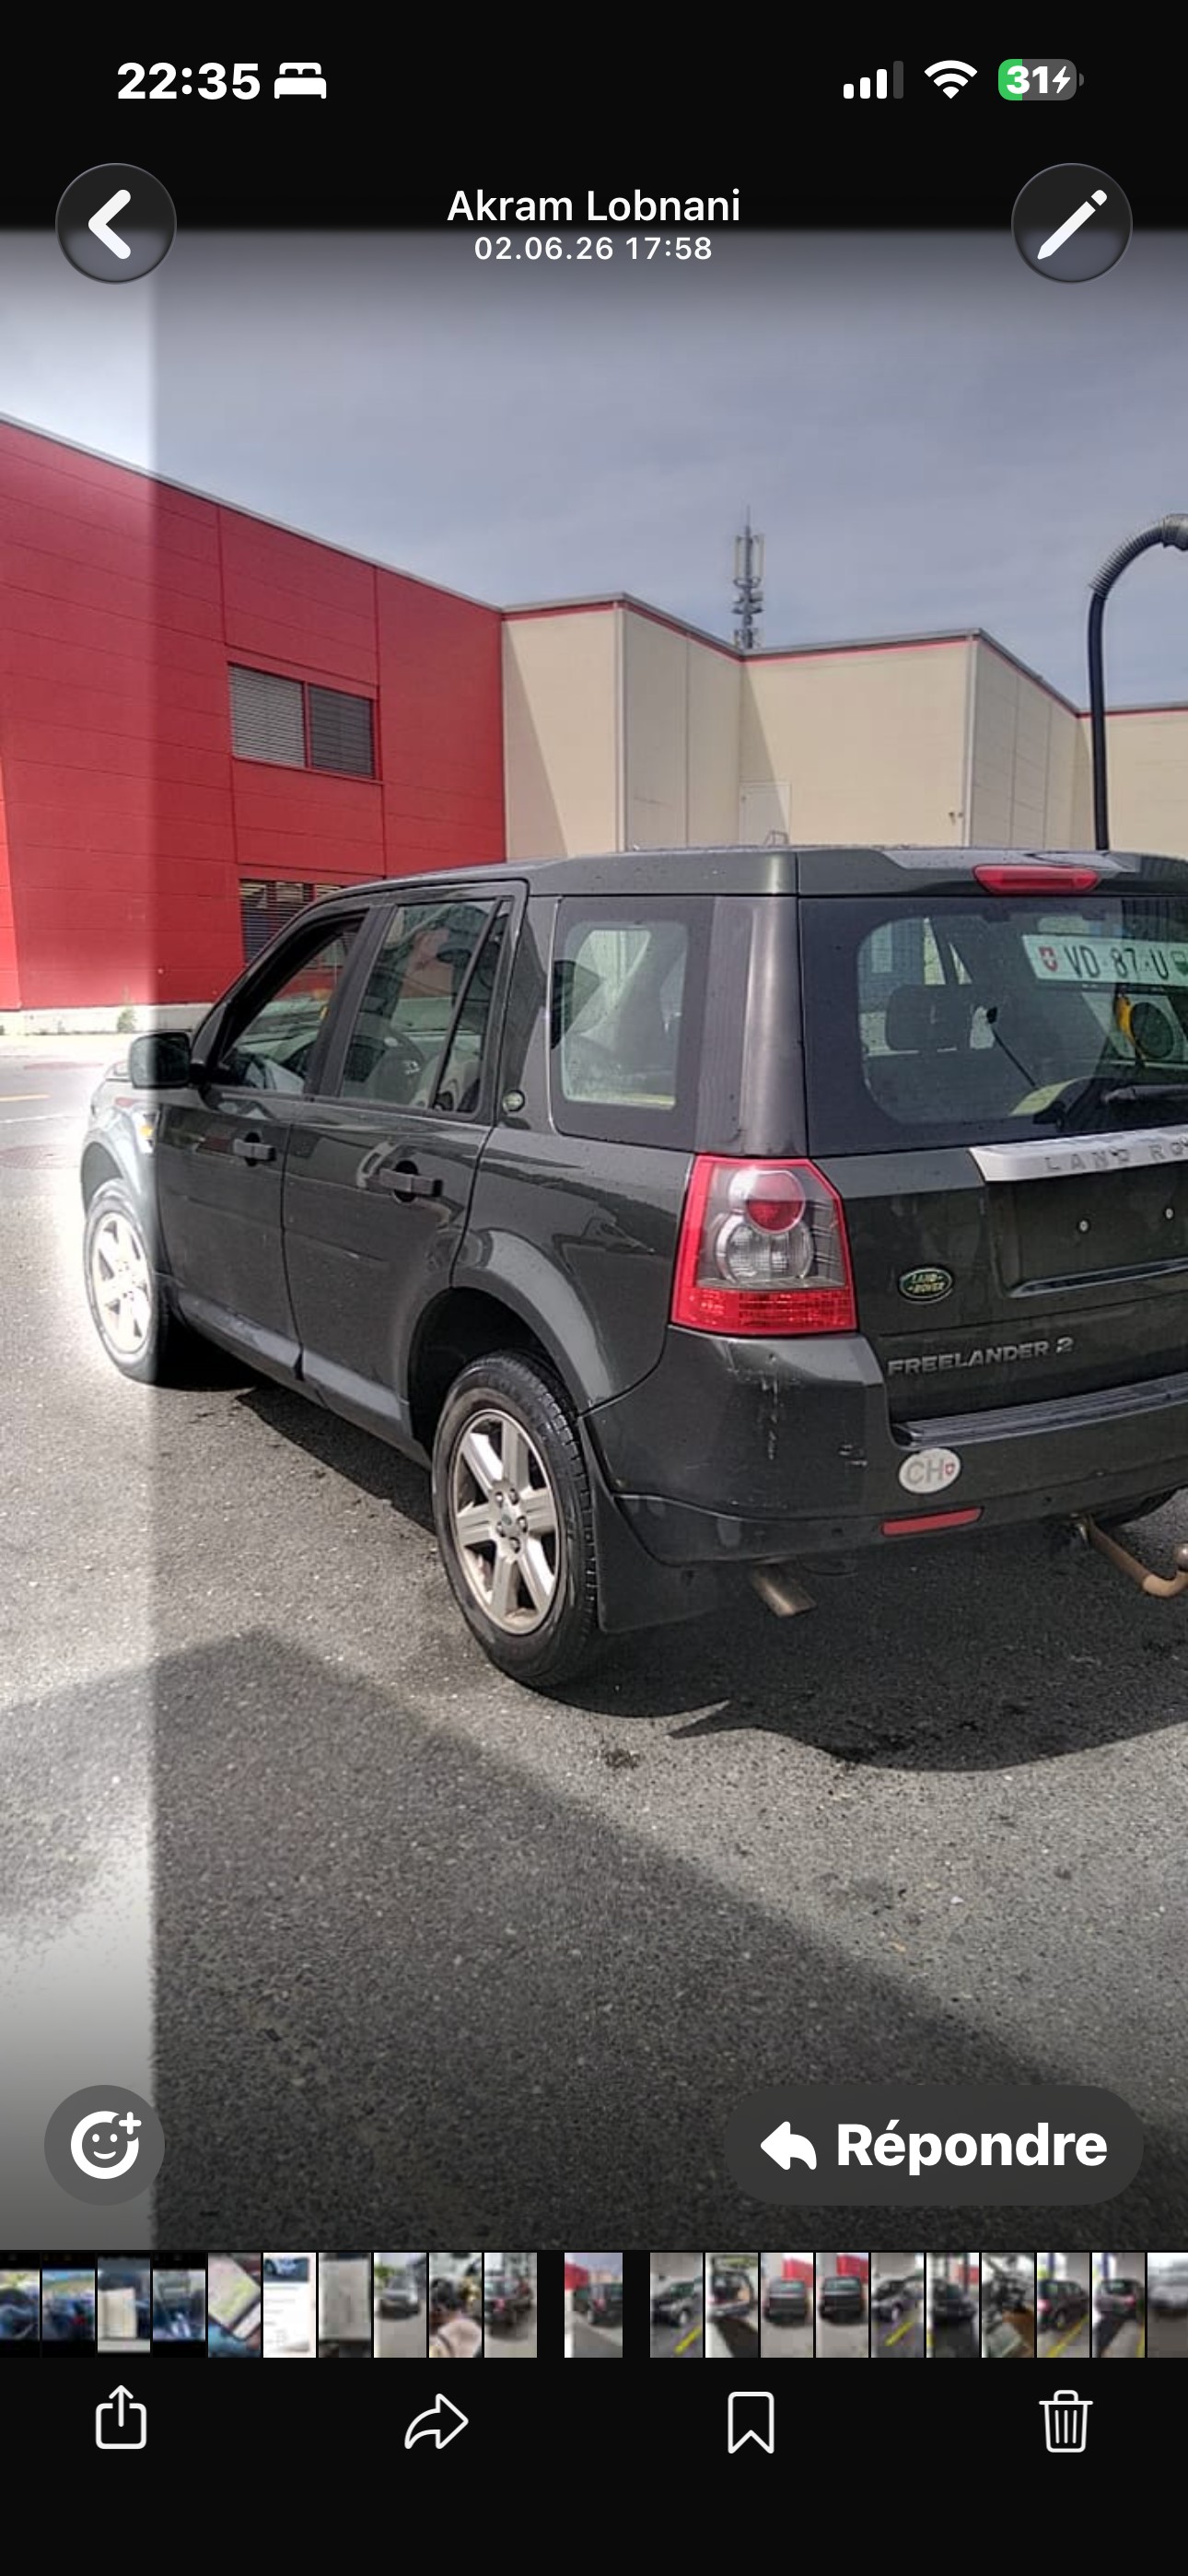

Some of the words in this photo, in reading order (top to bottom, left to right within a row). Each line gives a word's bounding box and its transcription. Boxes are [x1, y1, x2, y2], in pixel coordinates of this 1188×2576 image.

[1044, 1146, 1131, 1171] LAND
[887, 1341, 1050, 1376] FREELANDER
[1055, 1336, 1075, 1353] 2
[906, 1458, 945, 1486] CH
